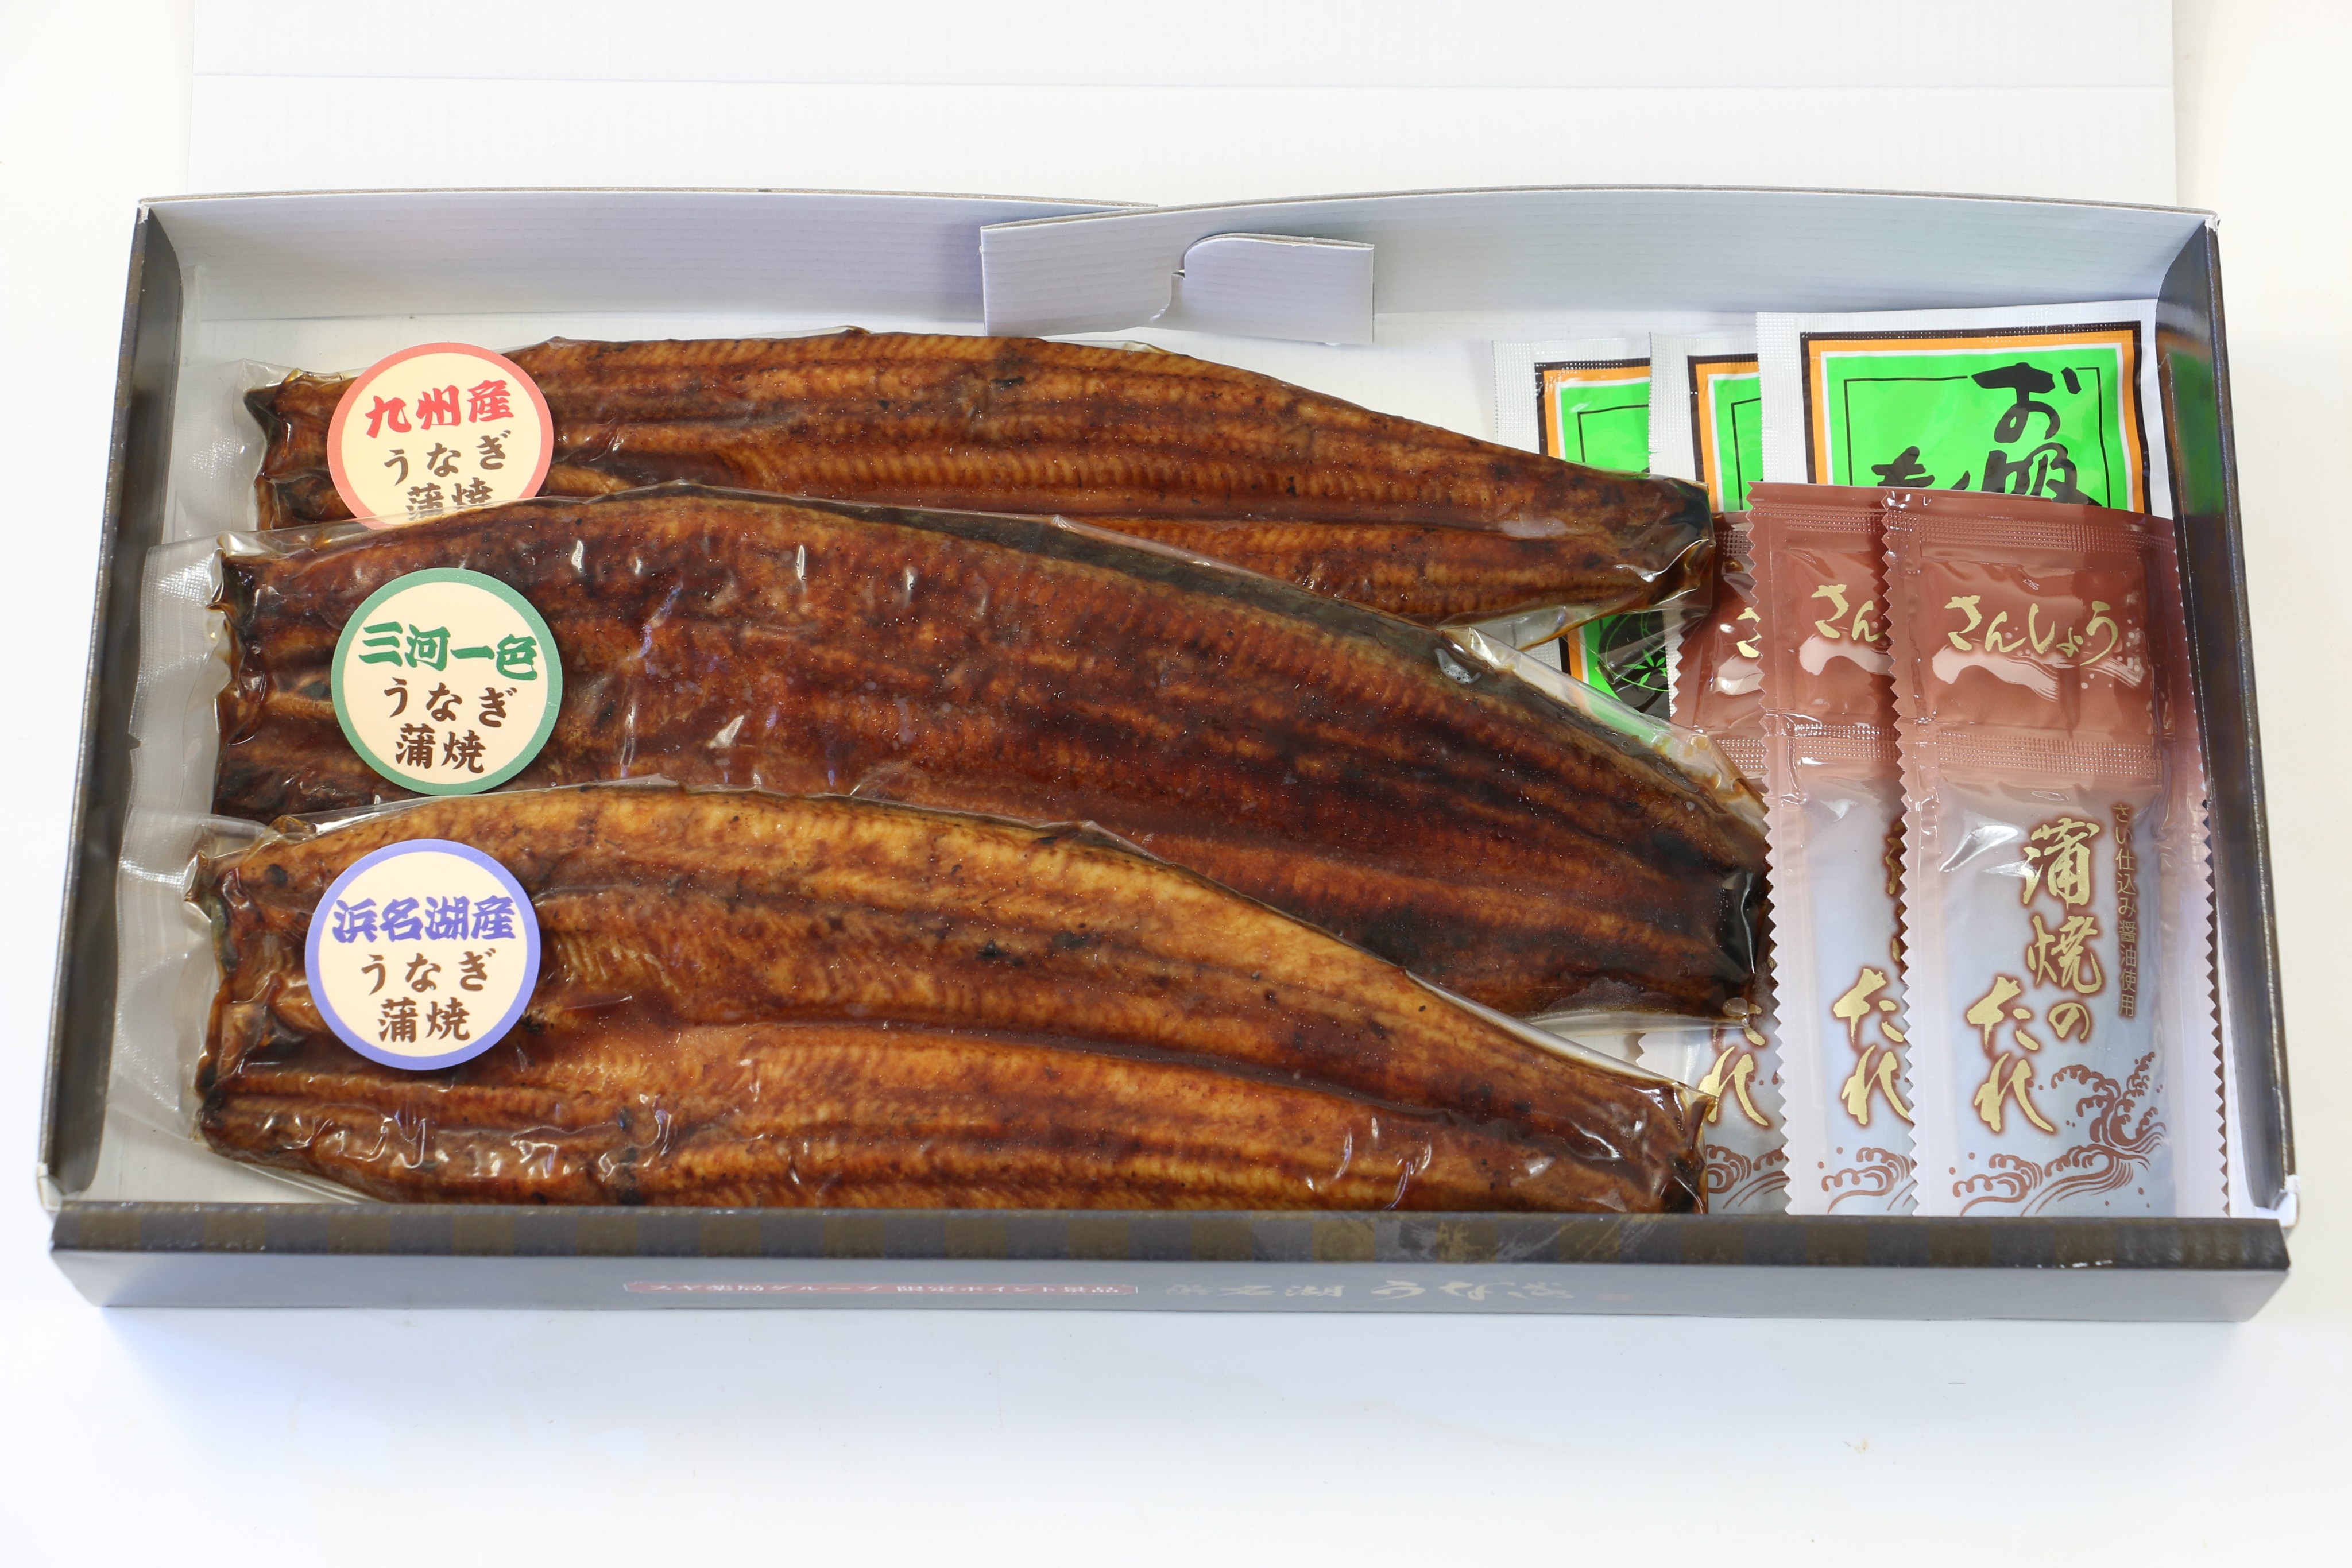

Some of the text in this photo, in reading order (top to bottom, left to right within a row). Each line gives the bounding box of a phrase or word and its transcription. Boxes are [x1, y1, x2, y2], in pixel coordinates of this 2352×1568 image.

[365, 379, 514, 438] 九州産
[384, 429, 512, 486] うなぎ
[358, 621, 538, 681] 三河一色
[1944, 595, 2119, 667] さんしょう
[384, 676, 517, 728] うなぎ
[395, 722, 486, 774] 蒲焼
[332, 895, 516, 943] 浜名湖産
[2021, 816, 2103, 1041] 蒲焼の
[361, 947, 496, 996] うなぎ
[377, 996, 471, 1043] 蒲焼
[1966, 975, 2055, 1133] たれ
